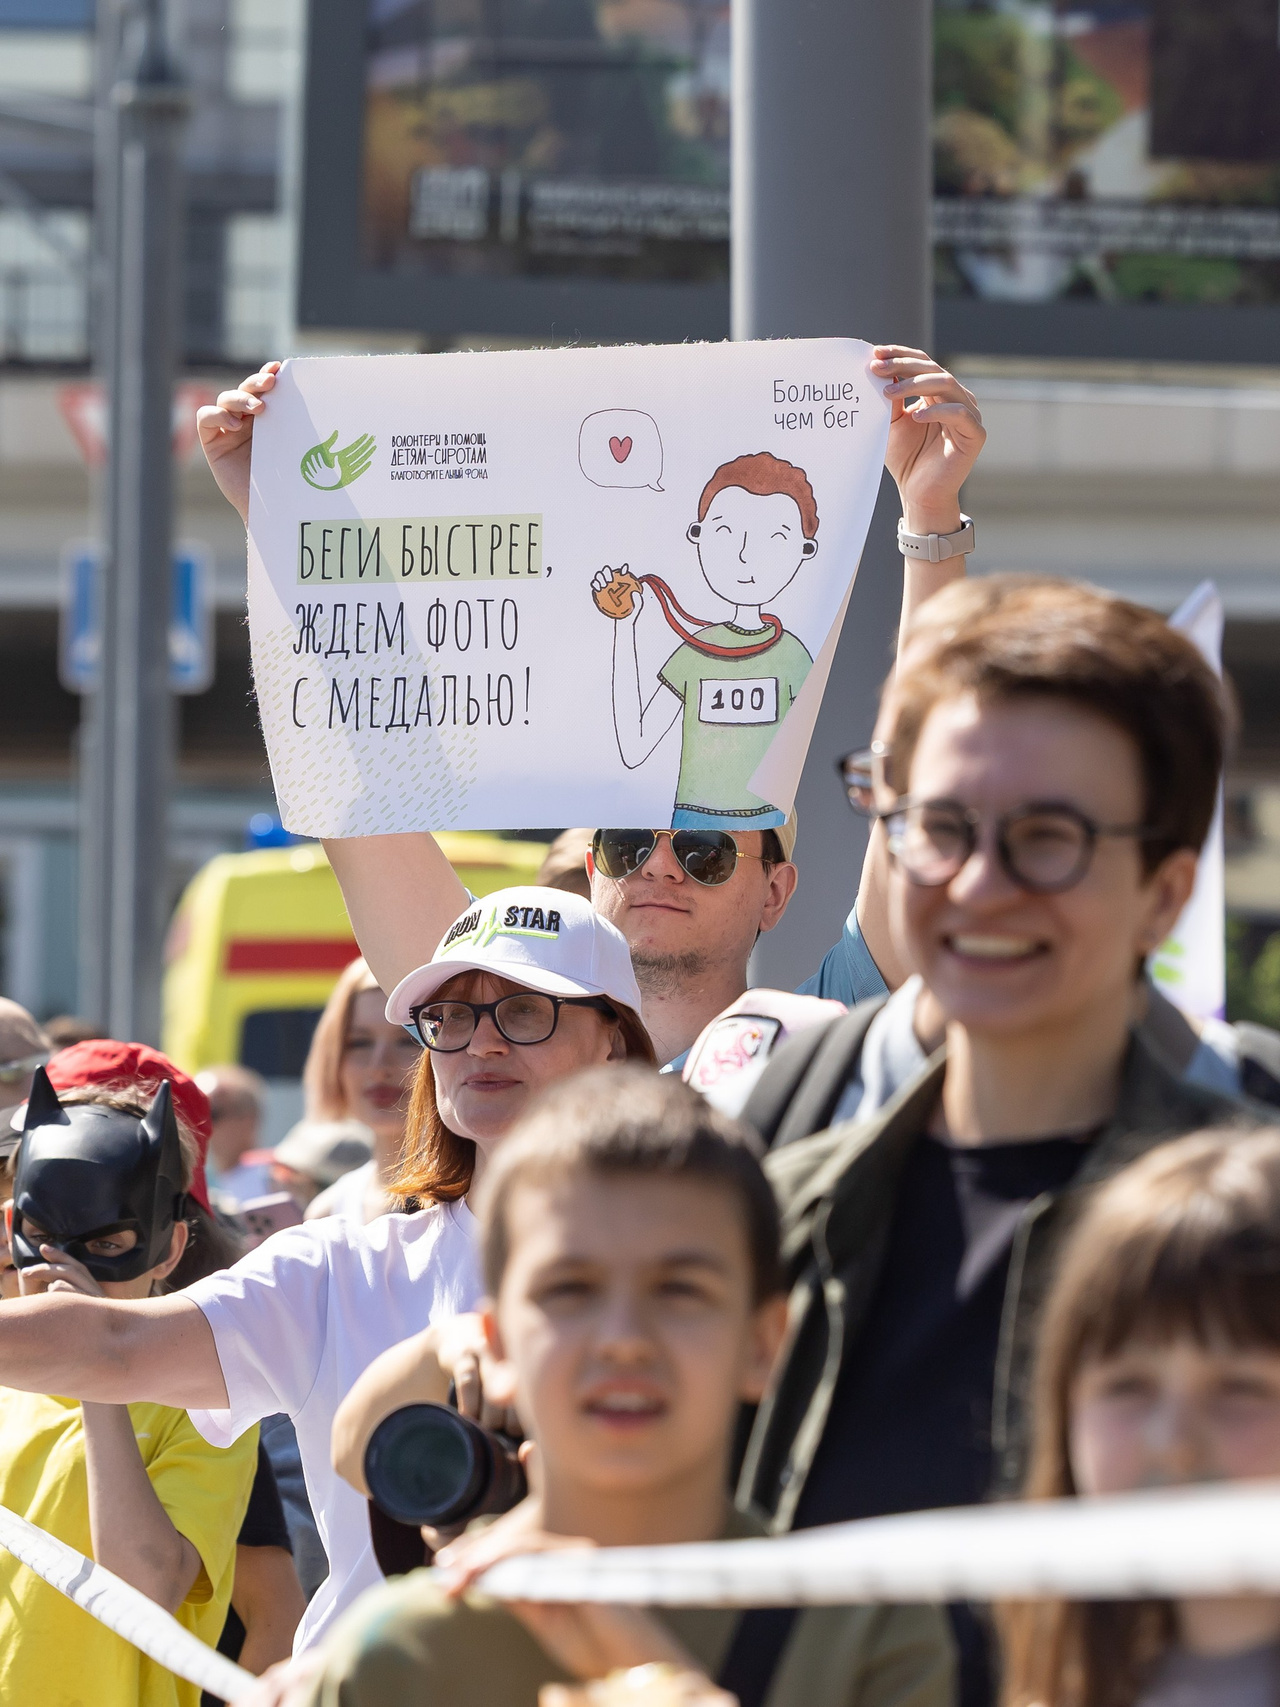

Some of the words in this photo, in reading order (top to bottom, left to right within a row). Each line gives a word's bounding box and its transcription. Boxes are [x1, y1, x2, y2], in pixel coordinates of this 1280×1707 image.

[773, 379, 860, 404] Больше,
[774, 411, 813, 430] чем
[823, 404, 860, 429] бег
[391, 434, 441, 448] ВОЛОНТЕРЫ
[444, 434, 449, 446] В
[450, 432, 487, 447] ПОМОЩЬ
[390, 447, 488, 467] ДЕТЯМ-СИРОТАМ
[390, 467, 464, 481] БЛАГОТВОРИТЕЛЬНЫЙ
[464, 468, 489, 480] ФОНД
[299, 521, 381, 581] БЕГИ
[400, 522, 553, 579] БЫСТРЕЕ,
[292, 601, 406, 661] ЖДЕМ
[426, 597, 519, 653] ФОТО
[291, 677, 309, 728] С
[327, 666, 531, 734] МЕДАЛЬЮ!
[710, 686, 765, 711] 100
[443, 908, 483, 948] IRON
[503, 904, 562, 933] STAR
